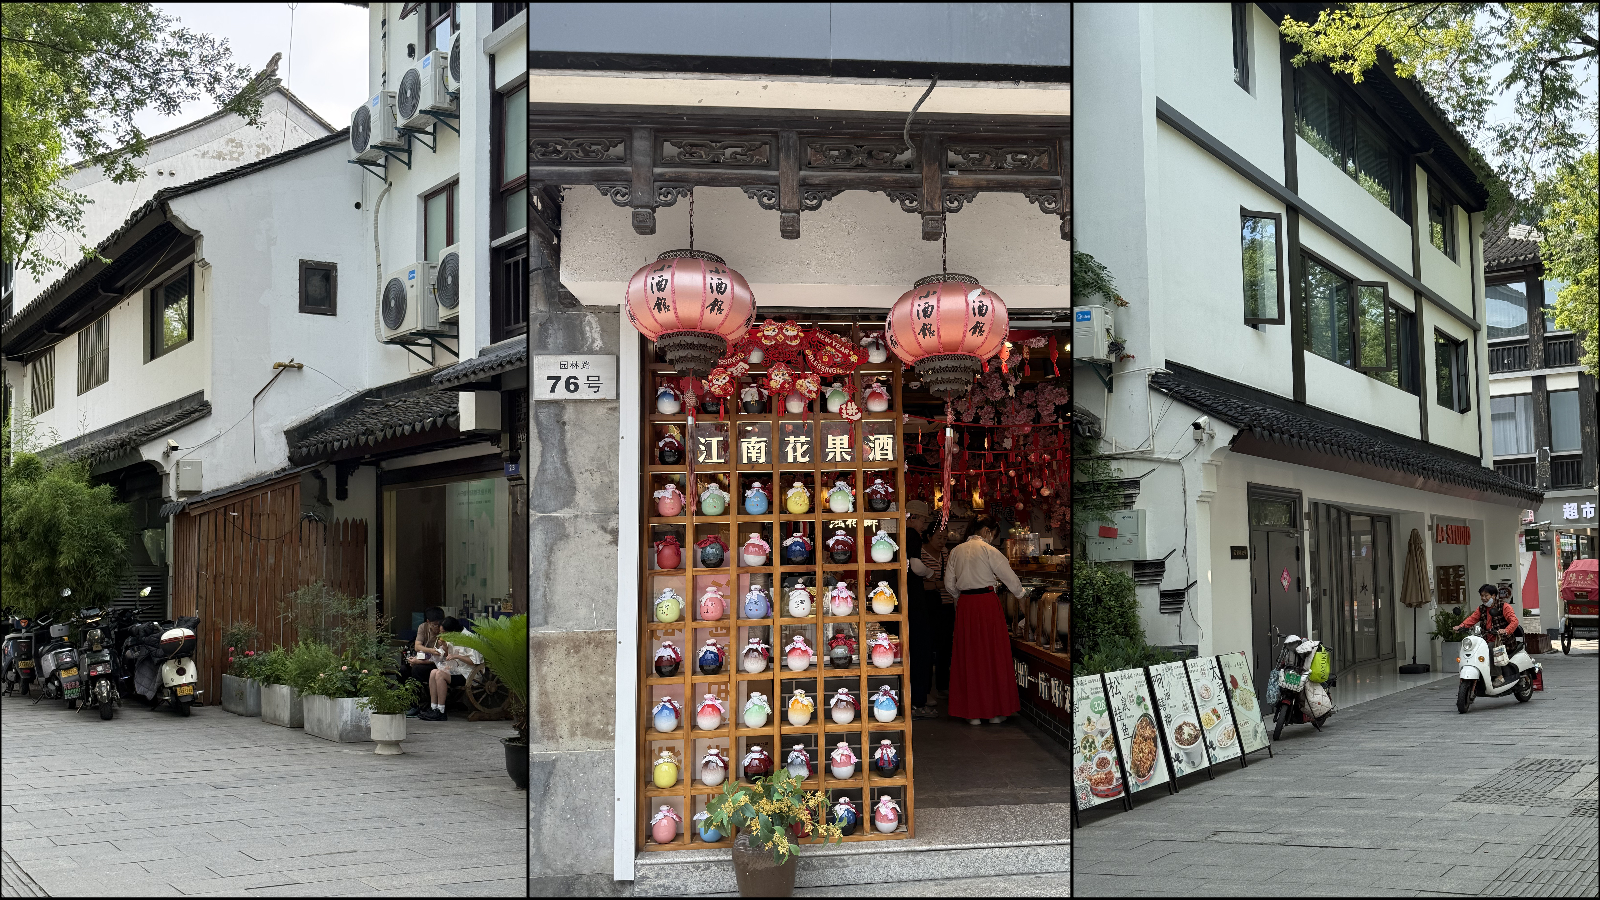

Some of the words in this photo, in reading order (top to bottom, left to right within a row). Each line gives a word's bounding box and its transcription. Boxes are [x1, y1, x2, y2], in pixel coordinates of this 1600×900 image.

[816, 331, 831, 344] NEW
[832, 340, 850, 355] YEAR
[560, 360, 590, 370] 园林路
[807, 354, 837, 374] BLESSING
[546, 375, 604, 394] 76号
[698, 434, 894, 464] 江南花果酒
[1563, 501, 1596, 520] 超市
[1446, 524, 1472, 545] STUDIO
